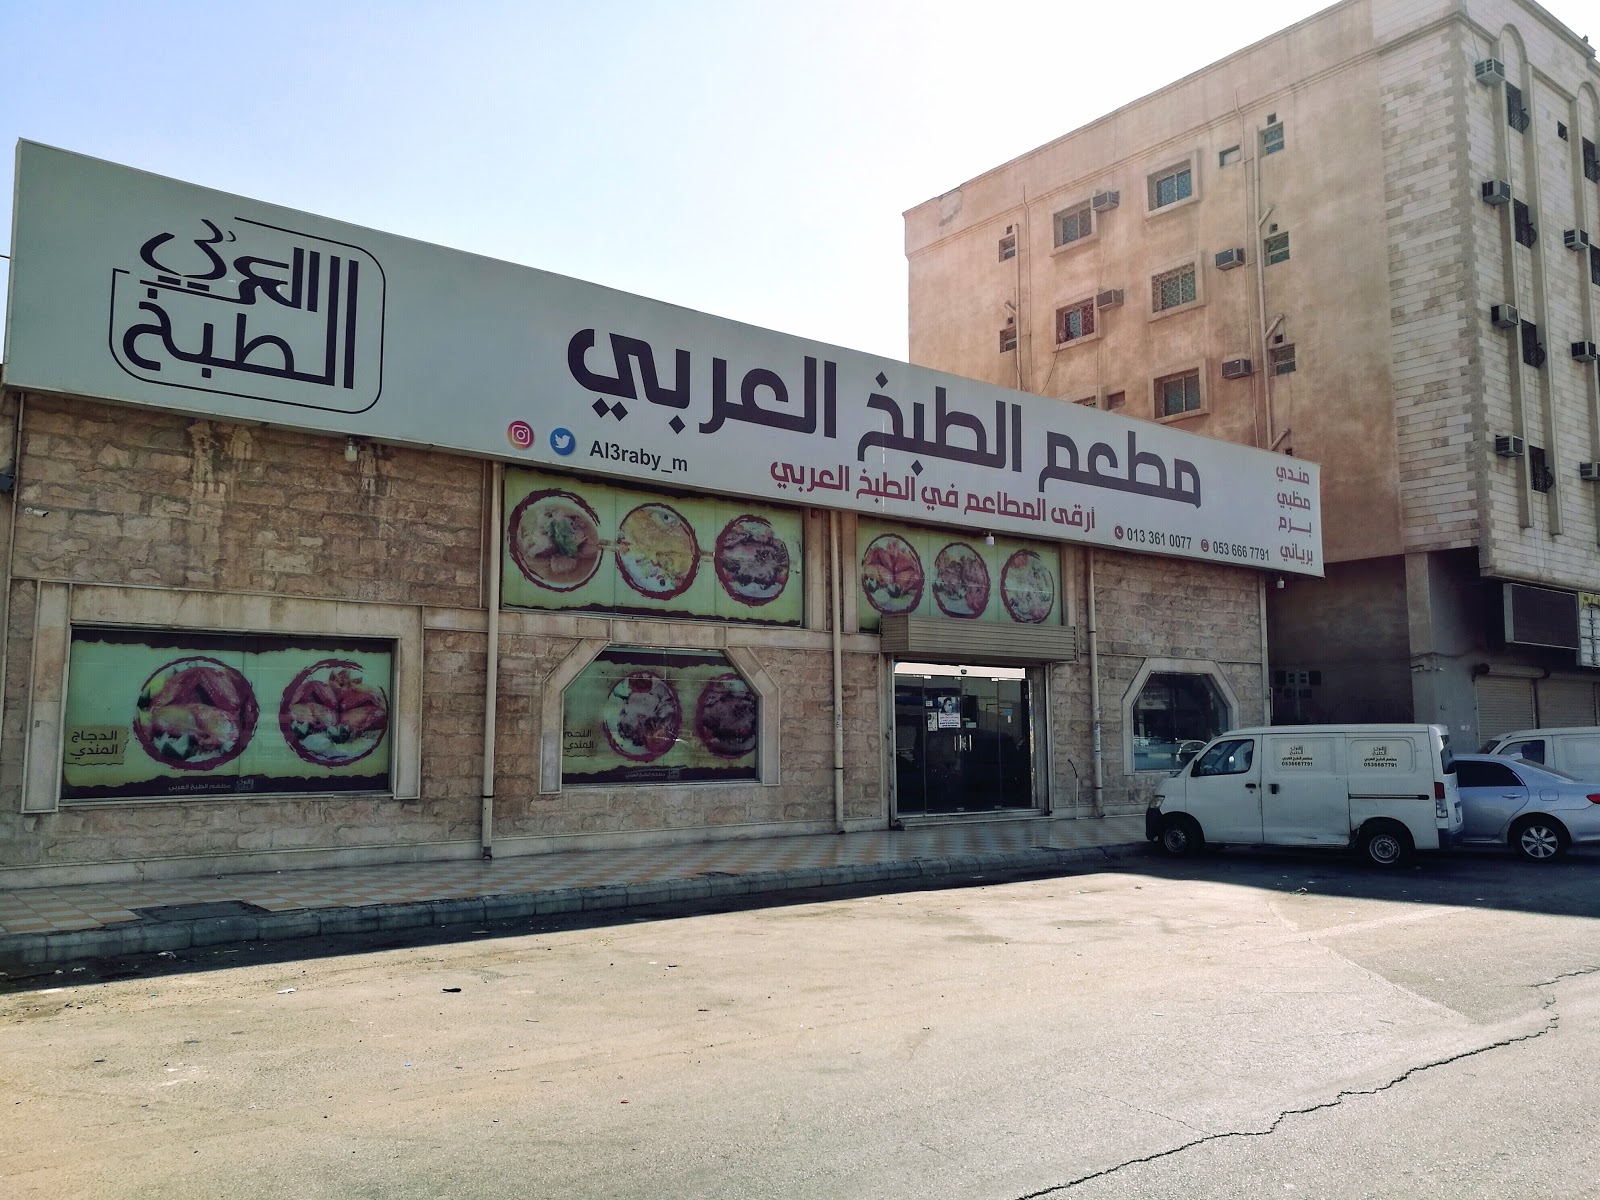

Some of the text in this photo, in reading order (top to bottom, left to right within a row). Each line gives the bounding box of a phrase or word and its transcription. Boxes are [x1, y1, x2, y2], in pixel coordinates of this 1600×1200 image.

[567, 328, 1202, 509] مطعم الطبخ العربي
[589, 439, 689, 474] Al3raby_m
[1276, 464, 1310, 485] مندي
[770, 461, 1096, 533] أرقى المطاعم في الطبخ العربي
[1277, 490, 1311, 511] مظبي
[1127, 527, 1192, 550] 013 361 0077
[1213, 540, 1270, 561] 053 666 7791
[1280, 543, 1313, 567] برياني
[71, 730, 118, 743] الدجاج
[563, 740, 594, 753] المندي
[69, 744, 118, 760] المندي
